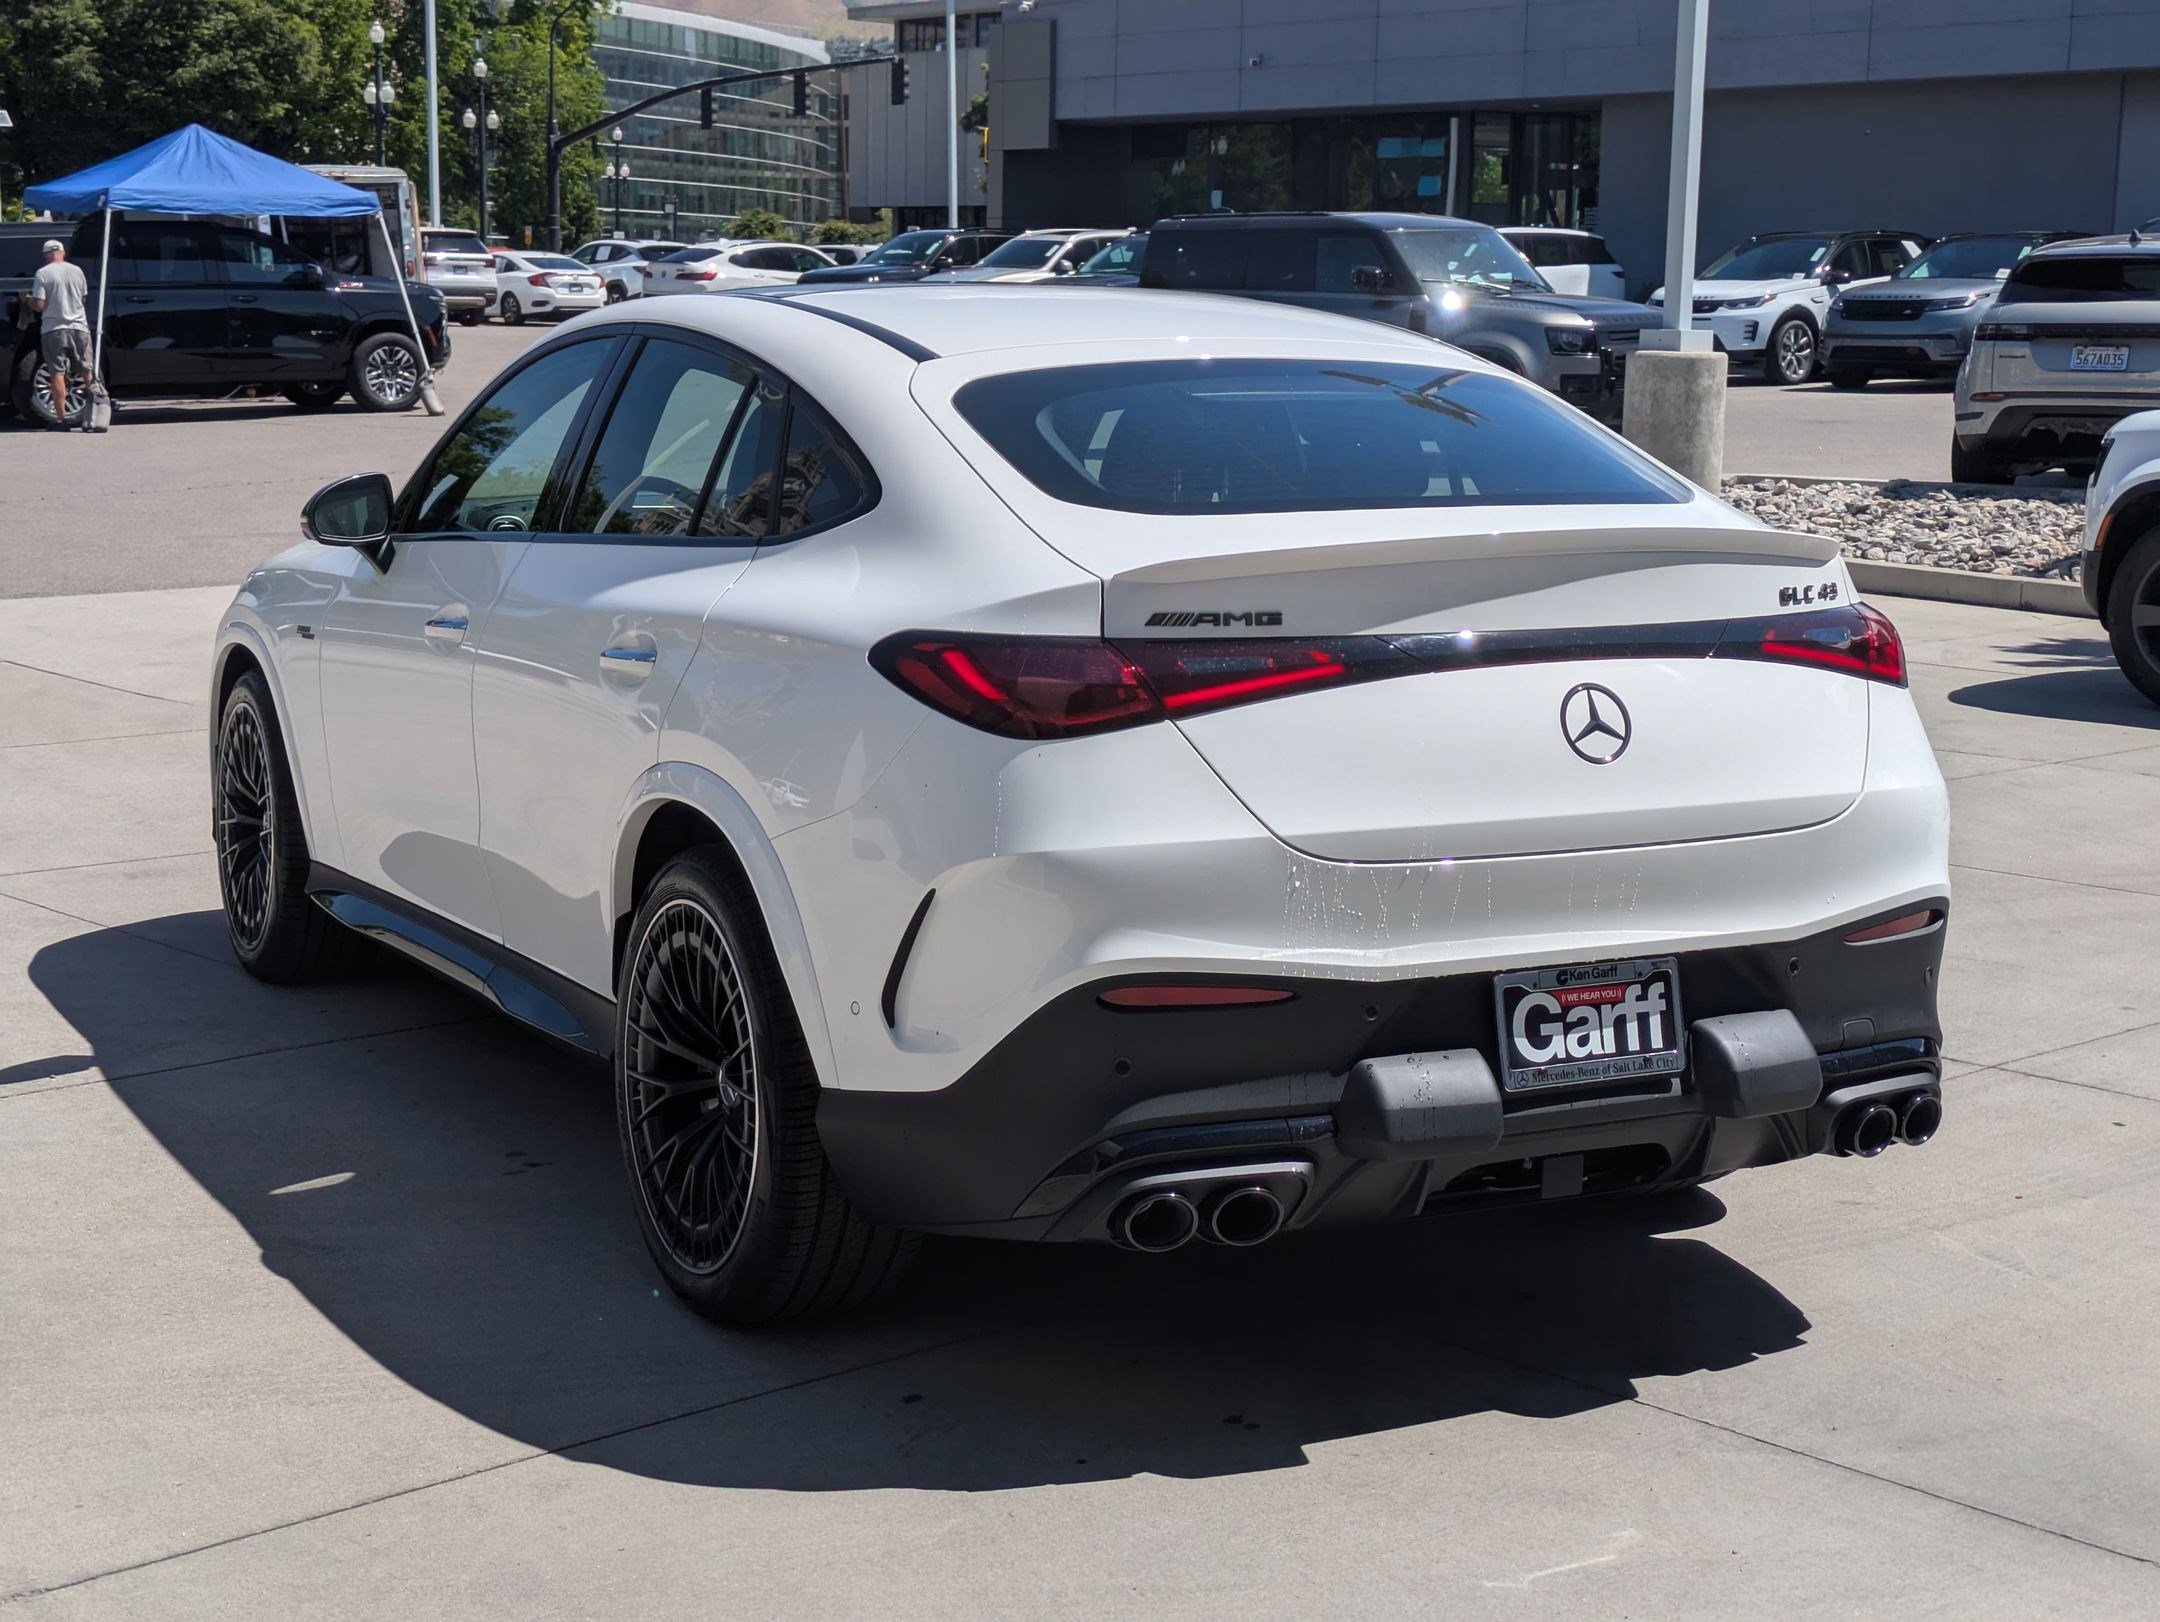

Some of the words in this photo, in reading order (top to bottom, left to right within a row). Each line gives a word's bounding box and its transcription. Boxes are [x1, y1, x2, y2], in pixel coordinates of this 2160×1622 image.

[1779, 585, 1815, 607] GLC
[1818, 582, 1838, 601] 43
[1569, 969, 1590, 981] Ken
[1592, 968, 1618, 979] Garff
[1567, 993, 1579, 1001] WE
[1580, 992, 1600, 1000] HEAR
[1602, 990, 1616, 998] YOU
[1513, 982, 1666, 1063] Garff
[1532, 1067, 1599, 1082] Mercedes-Benz
[1602, 1065, 1611, 1075] of
[1613, 1062, 1630, 1074] Salt
[1633, 1059, 1653, 1072] Lake
[1656, 1058, 1675, 1070] City
